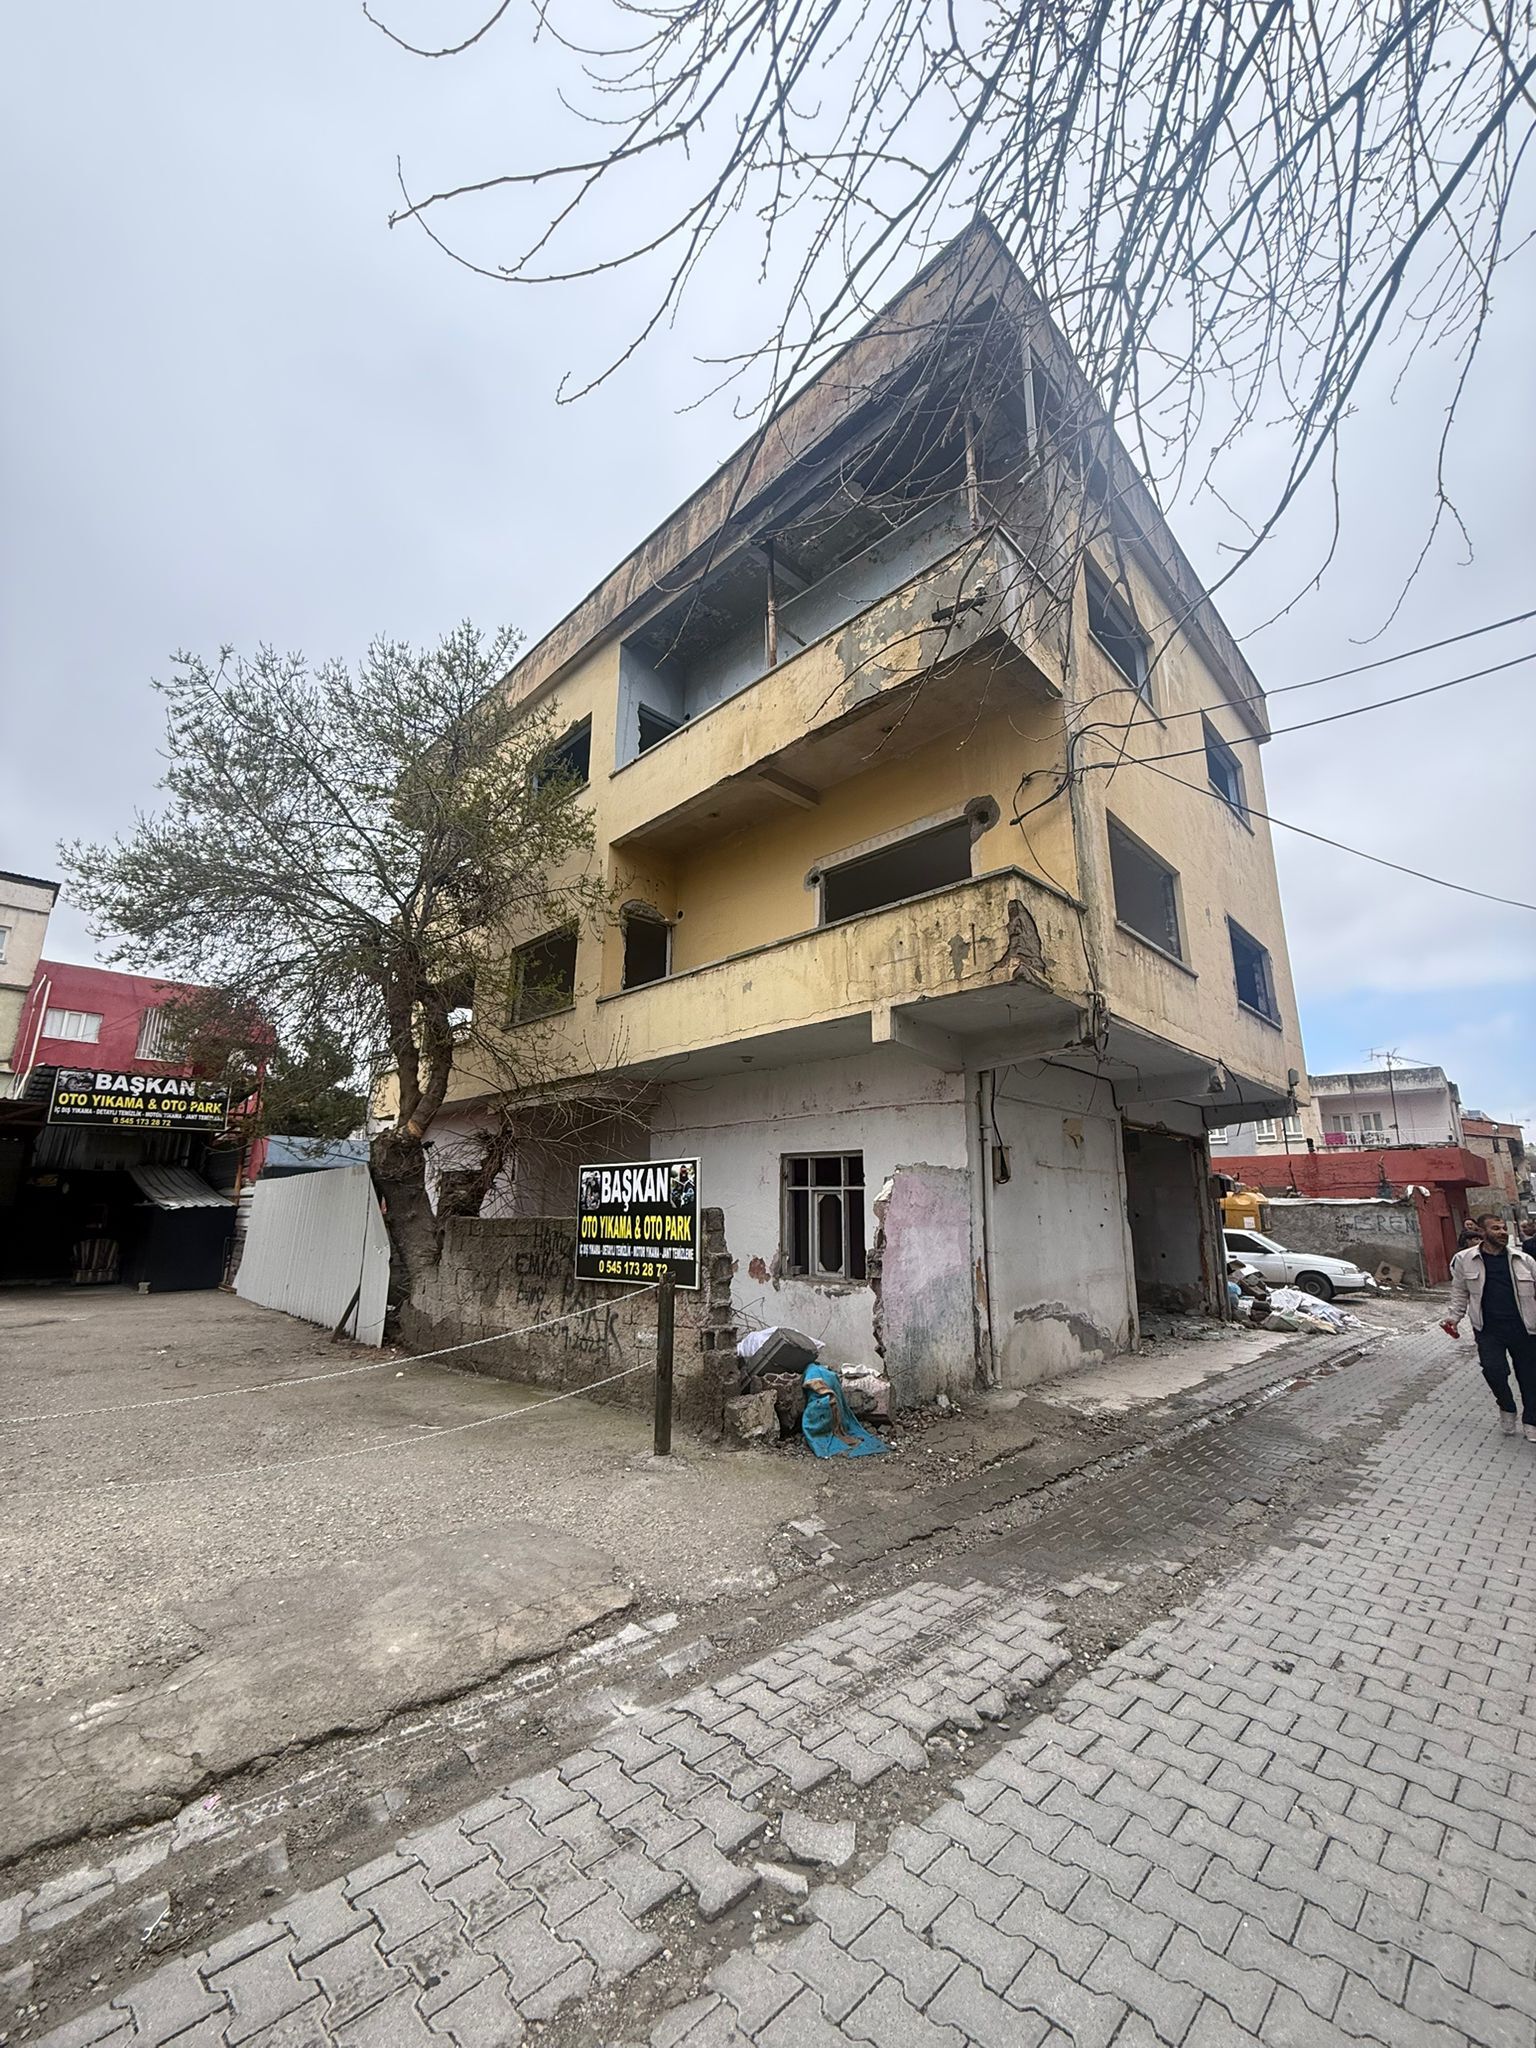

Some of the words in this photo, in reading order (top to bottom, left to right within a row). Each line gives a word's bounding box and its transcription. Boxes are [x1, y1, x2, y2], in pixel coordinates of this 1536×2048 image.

[94, 1073, 196, 1097] BAŞKAN
[58, 1092, 88, 1106] OTO
[92, 1094, 144, 1110] YIKAMA
[148, 1097, 157, 1110] &
[161, 1098, 187, 1112] OTO
[190, 1101, 223, 1114] PARK
[120, 1117, 134, 1125] 545
[162, 1119, 172, 1127] 72
[601, 1167, 669, 1212] BAŞKAN
[581, 1215, 598, 1239] OTO
[599, 1215, 633, 1239] YIKAMA
[634, 1215, 642, 1240] &
[643, 1215, 663, 1240] OTO
[665, 1215, 692, 1241] PARK
[598, 1259, 605, 1273] 0
[606, 1260, 622, 1274] 545
[624, 1261, 640, 1276] 173
[642, 1262, 654, 1277] 28
